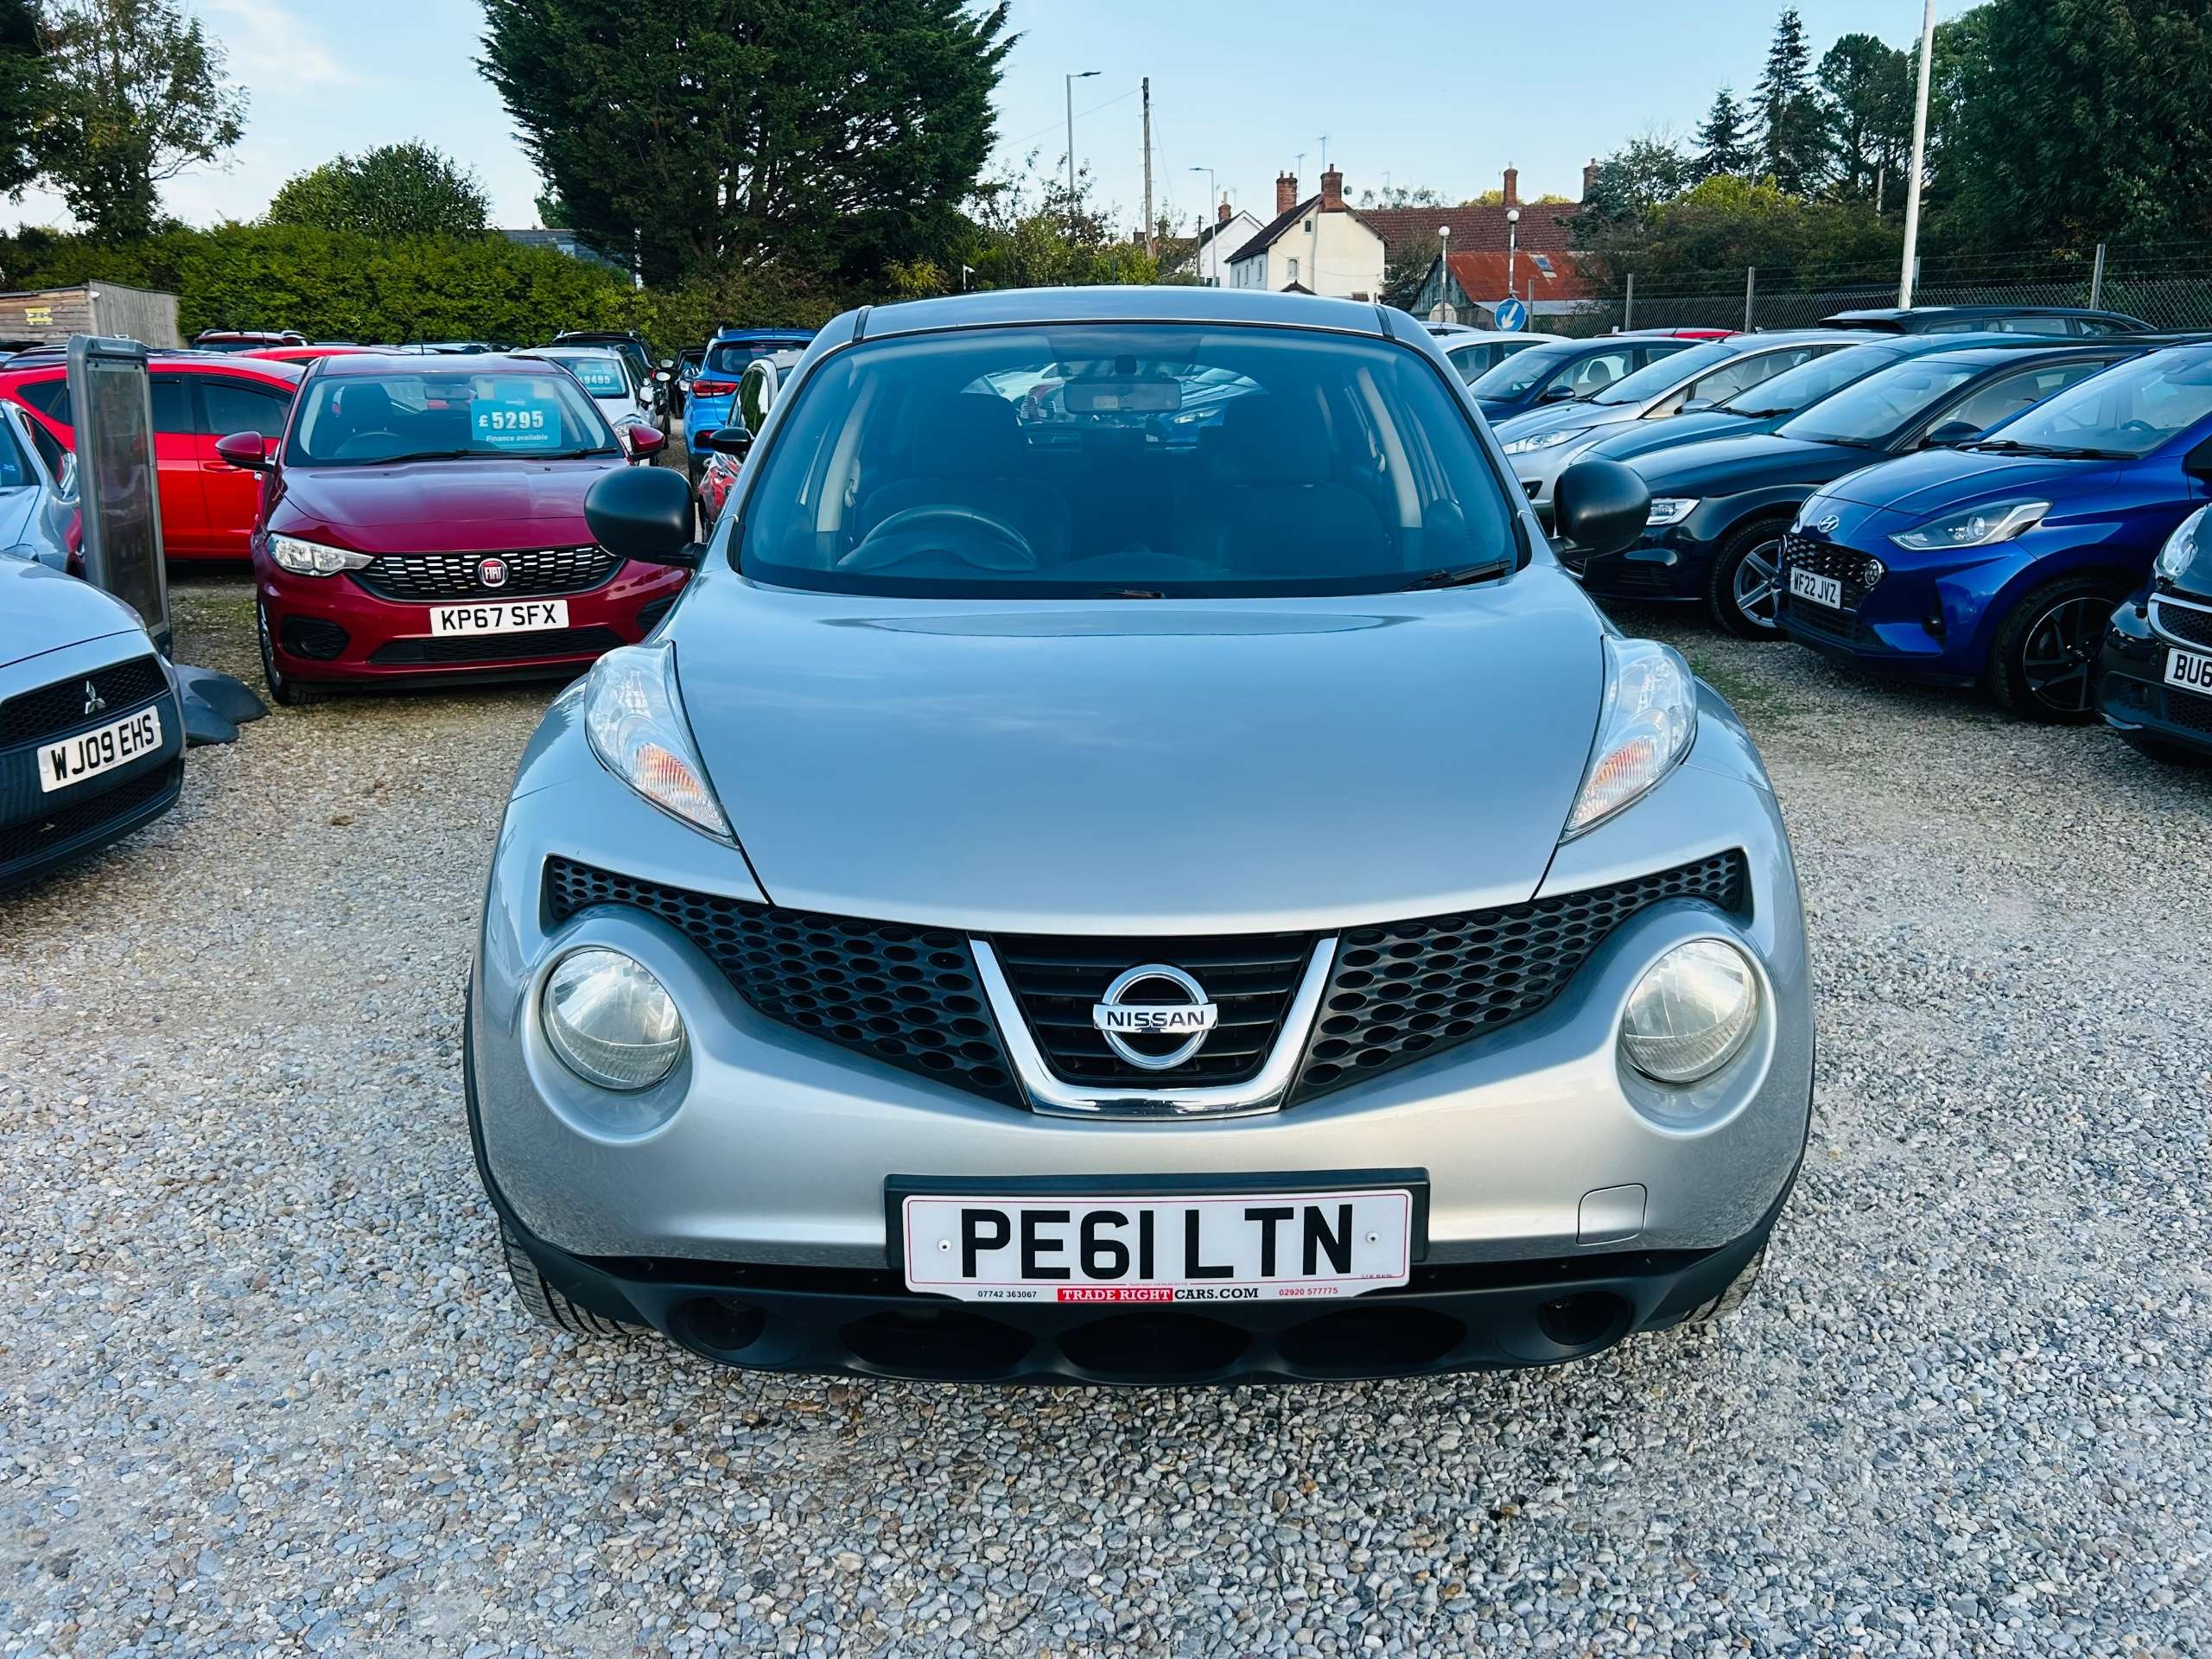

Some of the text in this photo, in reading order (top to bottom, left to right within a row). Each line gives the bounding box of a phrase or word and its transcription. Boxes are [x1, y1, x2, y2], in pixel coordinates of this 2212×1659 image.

[492, 410, 543, 429] 5295
[484, 566, 502, 580] FIAT
[1817, 580, 1836, 604] JVZ
[441, 603, 556, 630] KP67 SFX
[51, 714, 155, 781] WJ09 EHS
[1107, 1010, 1205, 1027] NISSAN
[1185, 1204, 1353, 1279] LTN
[1006, 1290, 1038, 1299] 363067
[1063, 1287, 1259, 1301] TRADE RIGHT CARS.COM
[1307, 1287, 1338, 1295] 577775
